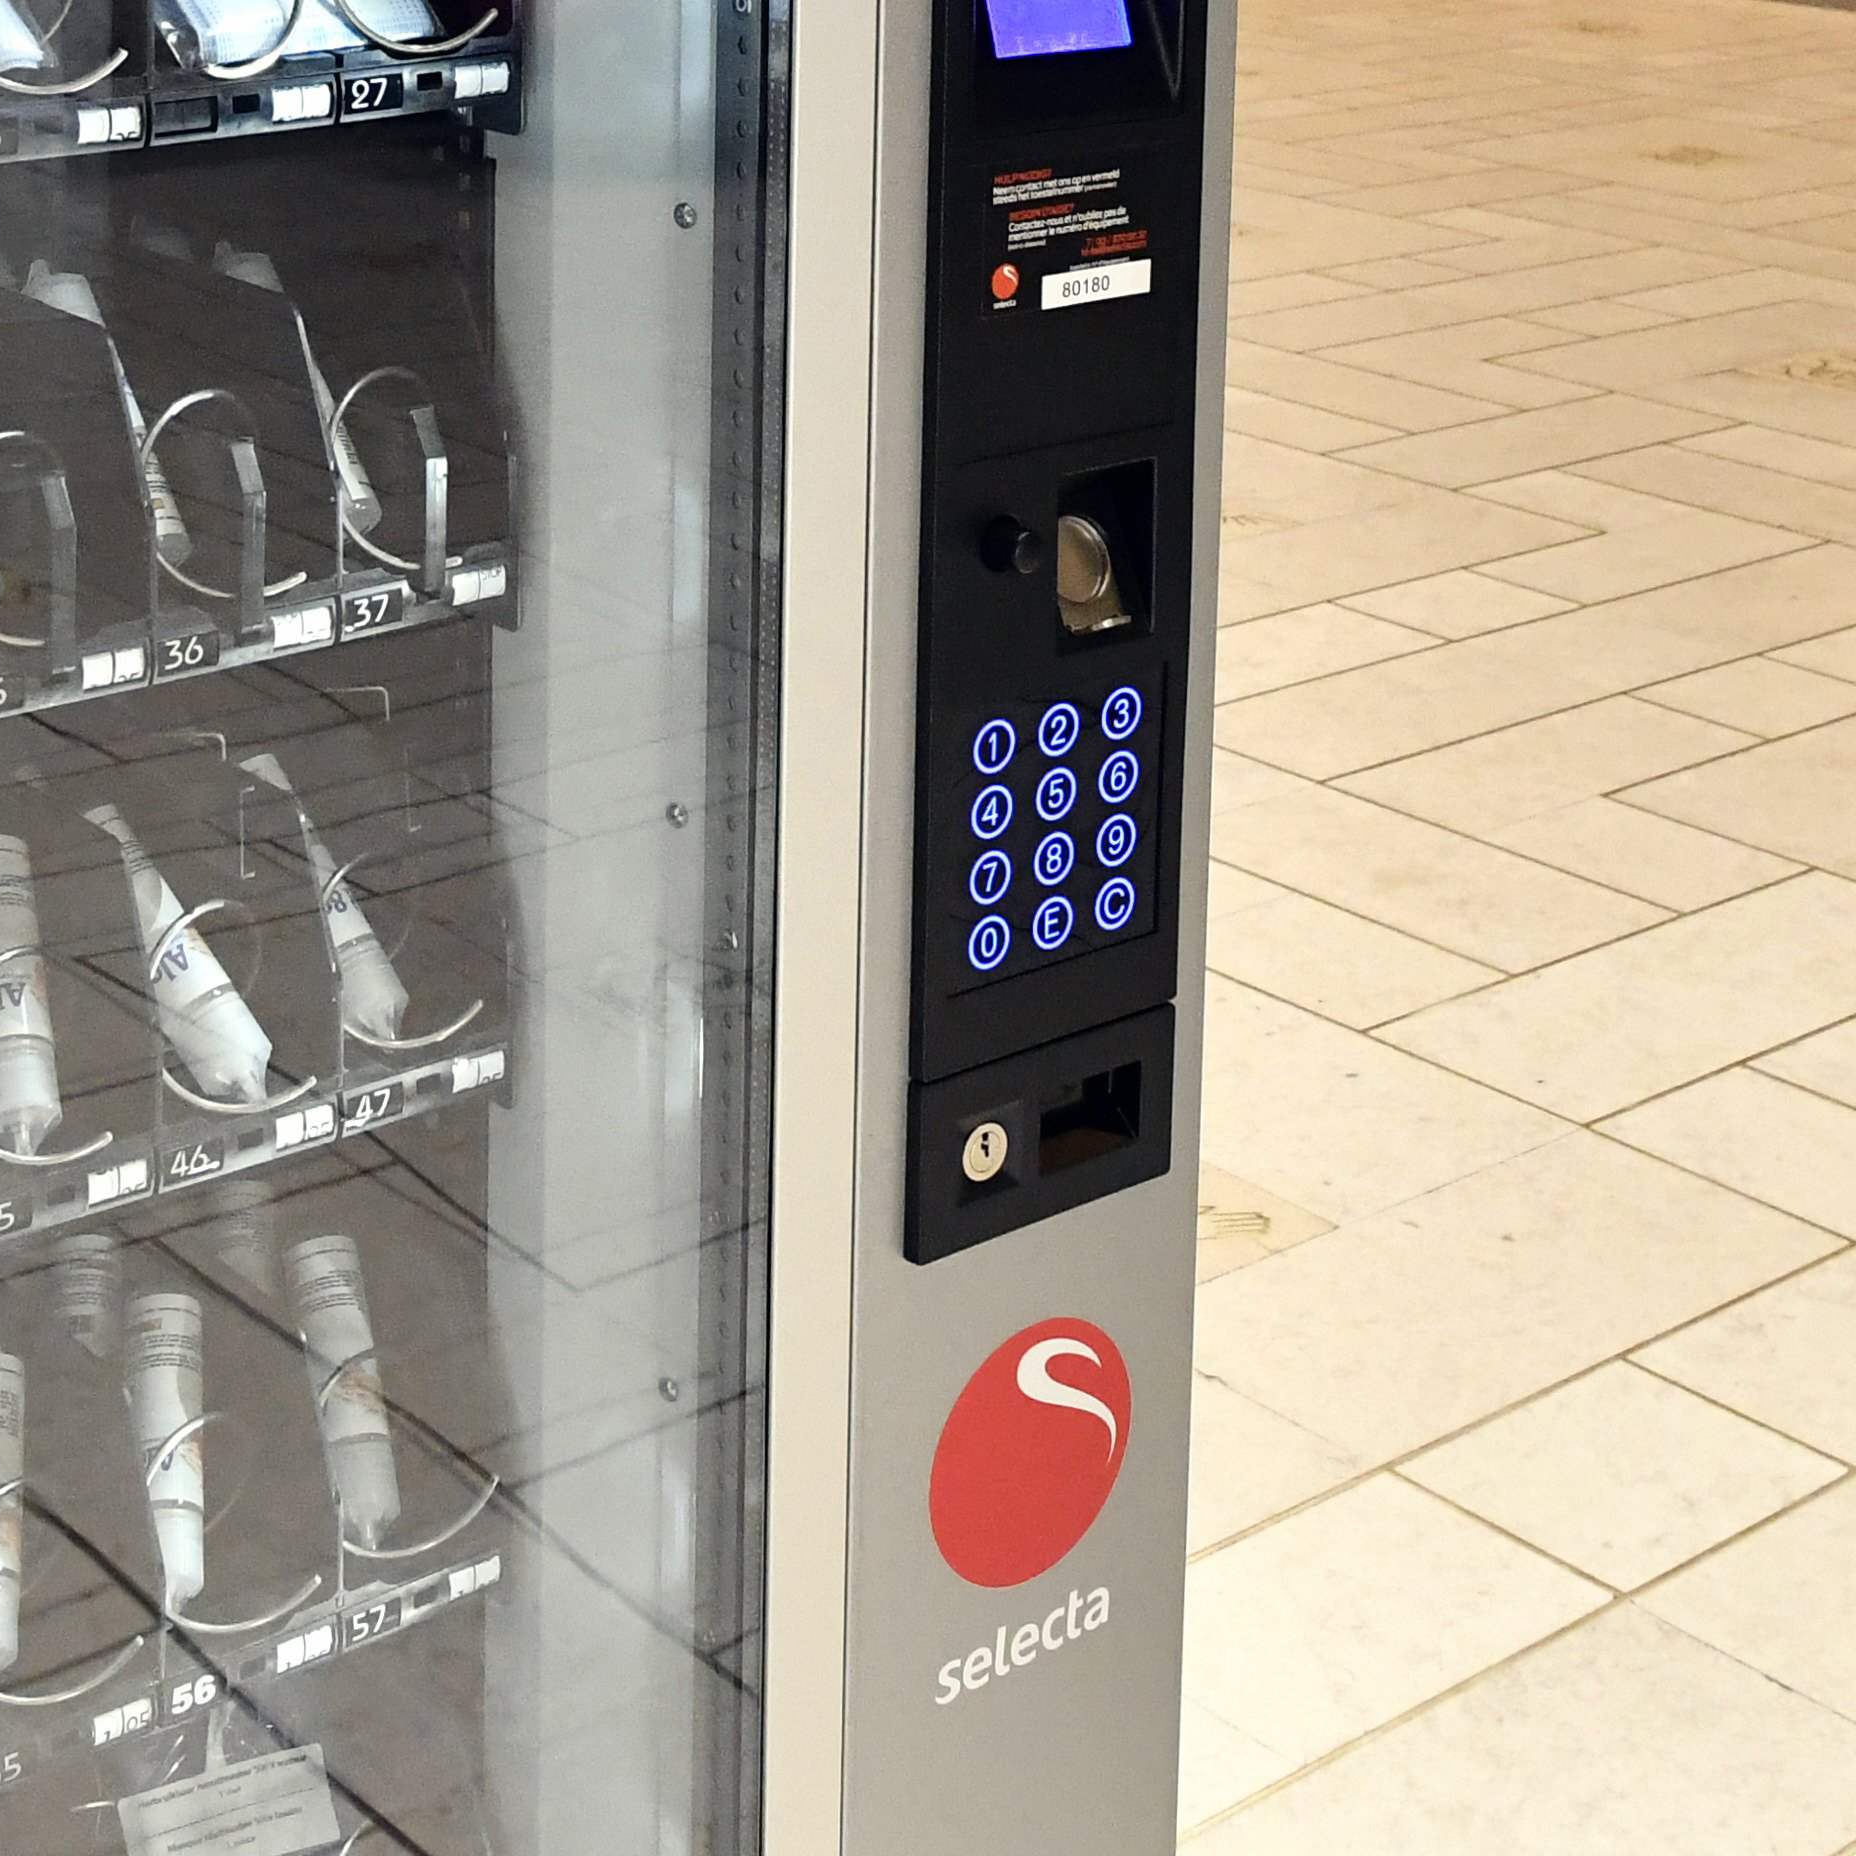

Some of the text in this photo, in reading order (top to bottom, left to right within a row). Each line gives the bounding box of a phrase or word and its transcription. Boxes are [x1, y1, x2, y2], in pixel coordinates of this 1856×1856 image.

[351, 77, 388, 110] 27
[1062, 275, 1111, 299] 80180
[353, 594, 390, 628] 37
[164, 635, 205, 671] 36
[1049, 715, 1067, 745] 2
[1113, 698, 1130, 729] 3
[982, 762, 1127, 827] 4 5 6
[982, 824, 1125, 892] 7 8 9
[1045, 907, 1061, 939] E
[1104, 889, 1126, 920] C
[355, 1088, 391, 1121] 47
[170, 1144, 214, 1178] 46
[351, 1604, 387, 1643] 57
[935, 1586, 1110, 1705] selecta
[171, 1674, 217, 1715] 56
